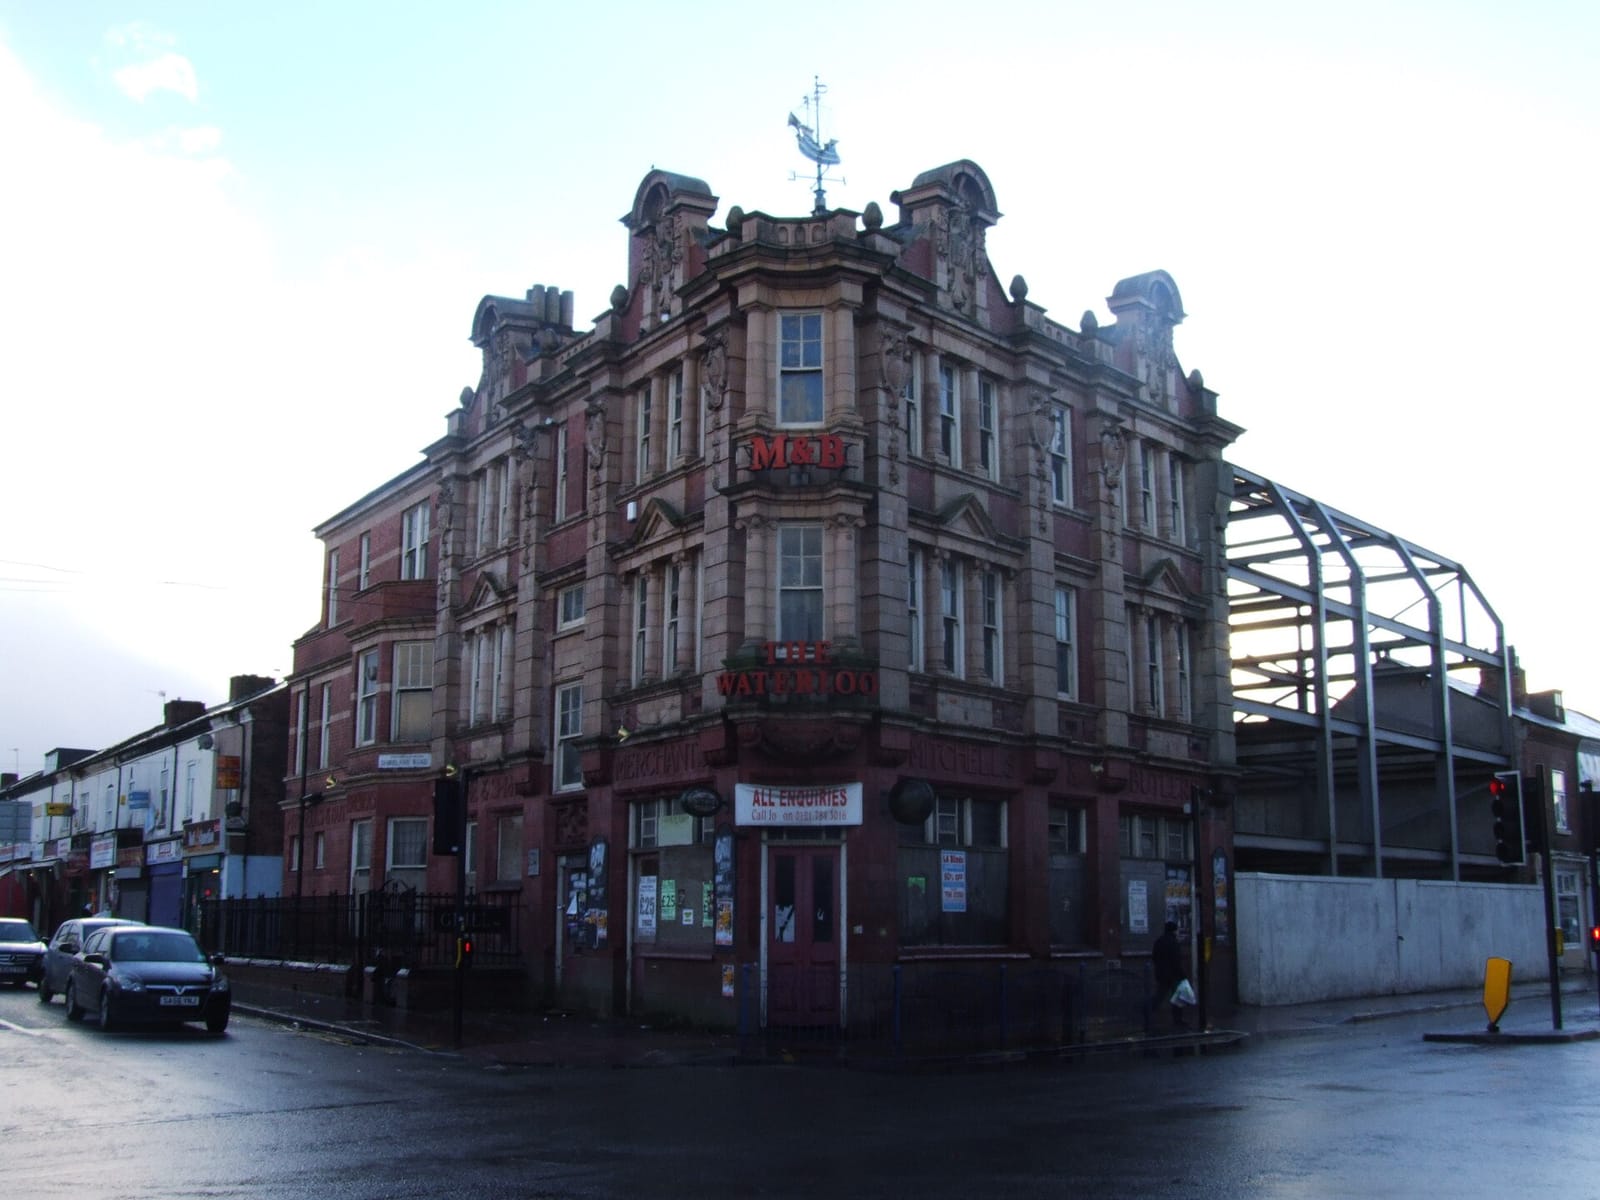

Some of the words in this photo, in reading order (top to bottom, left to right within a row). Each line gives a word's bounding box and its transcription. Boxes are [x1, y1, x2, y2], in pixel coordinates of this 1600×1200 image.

[751, 434, 846, 471] M&B
[763, 640, 832, 666] THE
[716, 670, 878, 698] WATERLOO
[752, 789, 775, 807] ALL
[780, 788, 848, 807] ENQUIRIES
[752, 810, 766, 821] Call
[783, 812, 793, 821] on
[661, 895, 676, 907] £25
